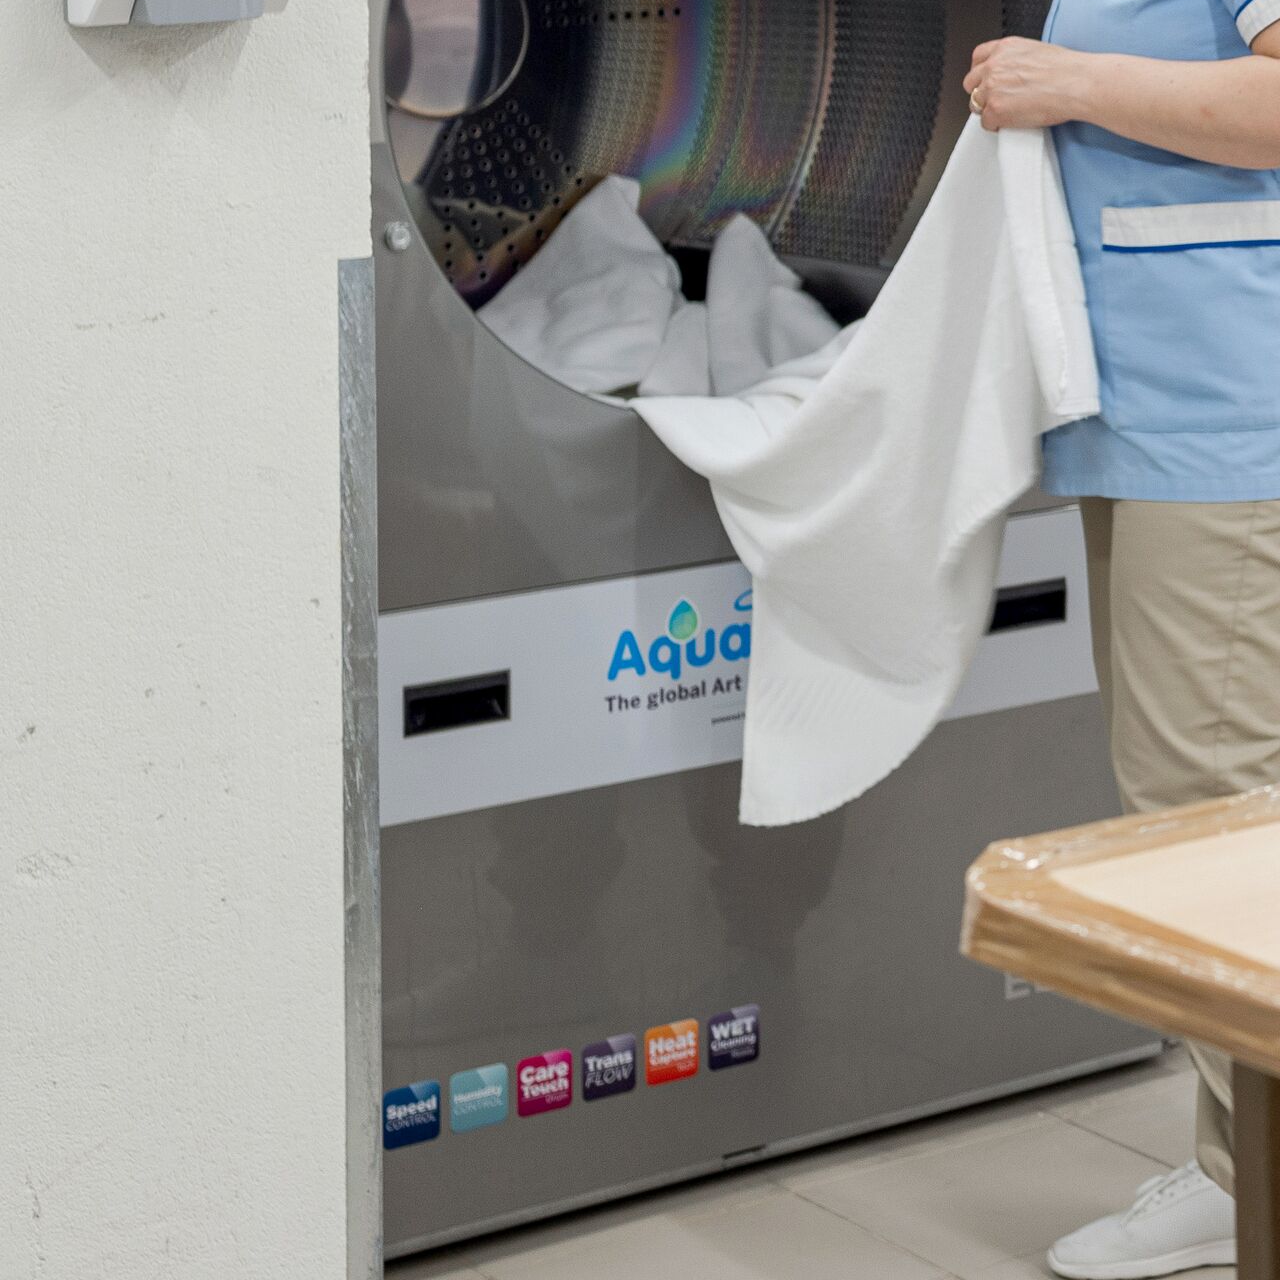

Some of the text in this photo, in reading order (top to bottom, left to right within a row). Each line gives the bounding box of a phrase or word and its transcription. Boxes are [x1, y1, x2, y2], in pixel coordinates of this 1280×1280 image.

[607, 622, 751, 681] Aqua
[605, 674, 743, 713] The global Art
[711, 1014, 757, 1041] WET
[649, 1030, 697, 1056] Heat
[711, 1032, 757, 1053] Cleaning
[519, 1061, 569, 1085] Care
[584, 1050, 633, 1072] Trans
[520, 1076, 569, 1100] Touch
[584, 1064, 634, 1090] FLOW
[386, 1093, 437, 1120] Speed
[385, 1110, 437, 1133] CONTROL
